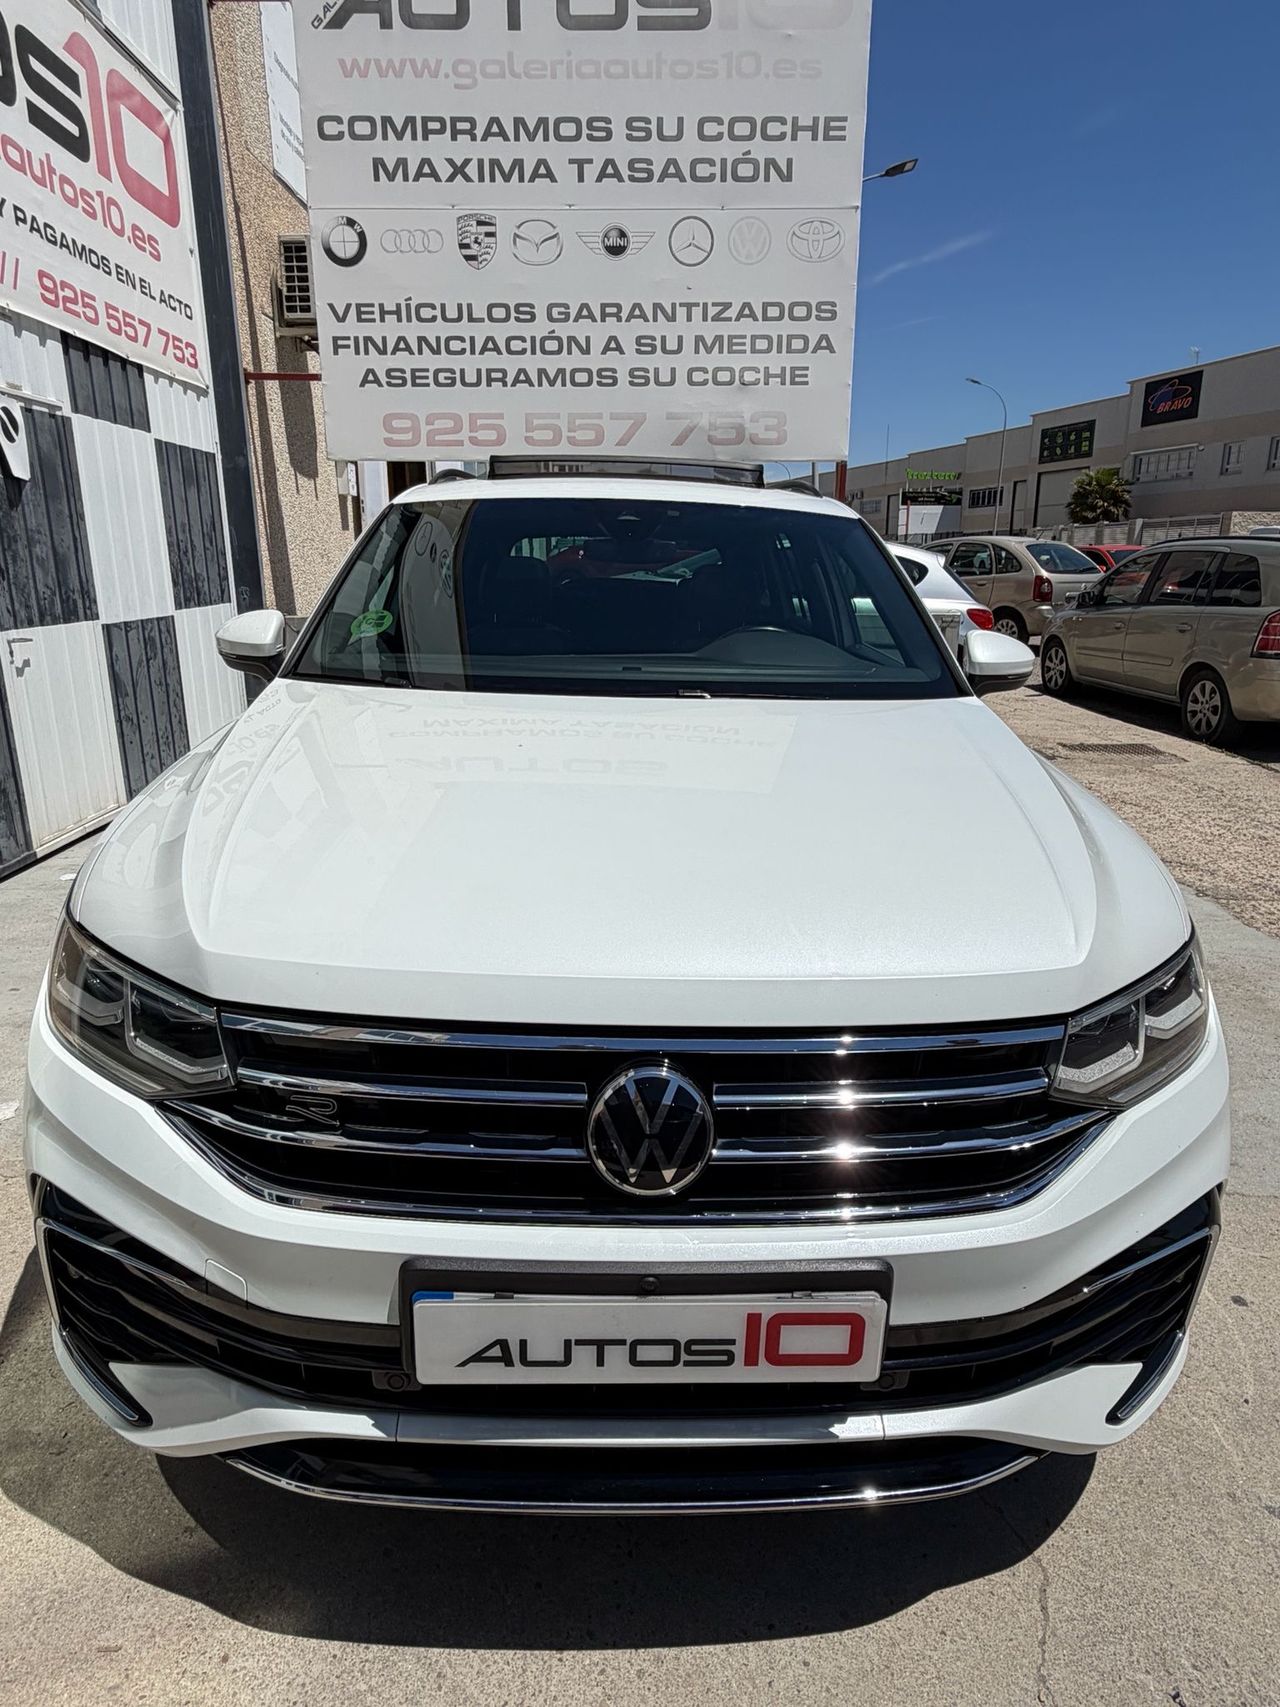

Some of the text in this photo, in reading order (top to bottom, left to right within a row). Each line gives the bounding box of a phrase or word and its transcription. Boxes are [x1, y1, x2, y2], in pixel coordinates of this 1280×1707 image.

[337, 49, 823, 90] www.galeriaautos10.es
[317, 115, 614, 143] COMPRAMOS
[625, 116, 684, 142] SU
[697, 116, 848, 142] COCHE
[372, 149, 793, 183] MAXIMA TASACIÓN
[604, 237, 627, 248] MINI
[13, 203, 112, 277] PAGAMOS
[115, 262, 137, 291] EN
[139, 276, 157, 301] EL
[159, 289, 193, 321] ACTO
[38, 269, 100, 326] 925
[104, 301, 152, 348] 557
[157, 327, 199, 369] 753
[328, 296, 838, 323] VEHÍCULOS GARANTIZADOS
[332, 329, 837, 356] FINANCIACIÓN A SU MEDIDA
[359, 366, 810, 388] ASEGURAMOS SU COCHE
[1156, 396, 1192, 414] BRAVO
[382, 411, 788, 447] 925 557 753
[454, 1312, 867, 1368] AUTOS10
